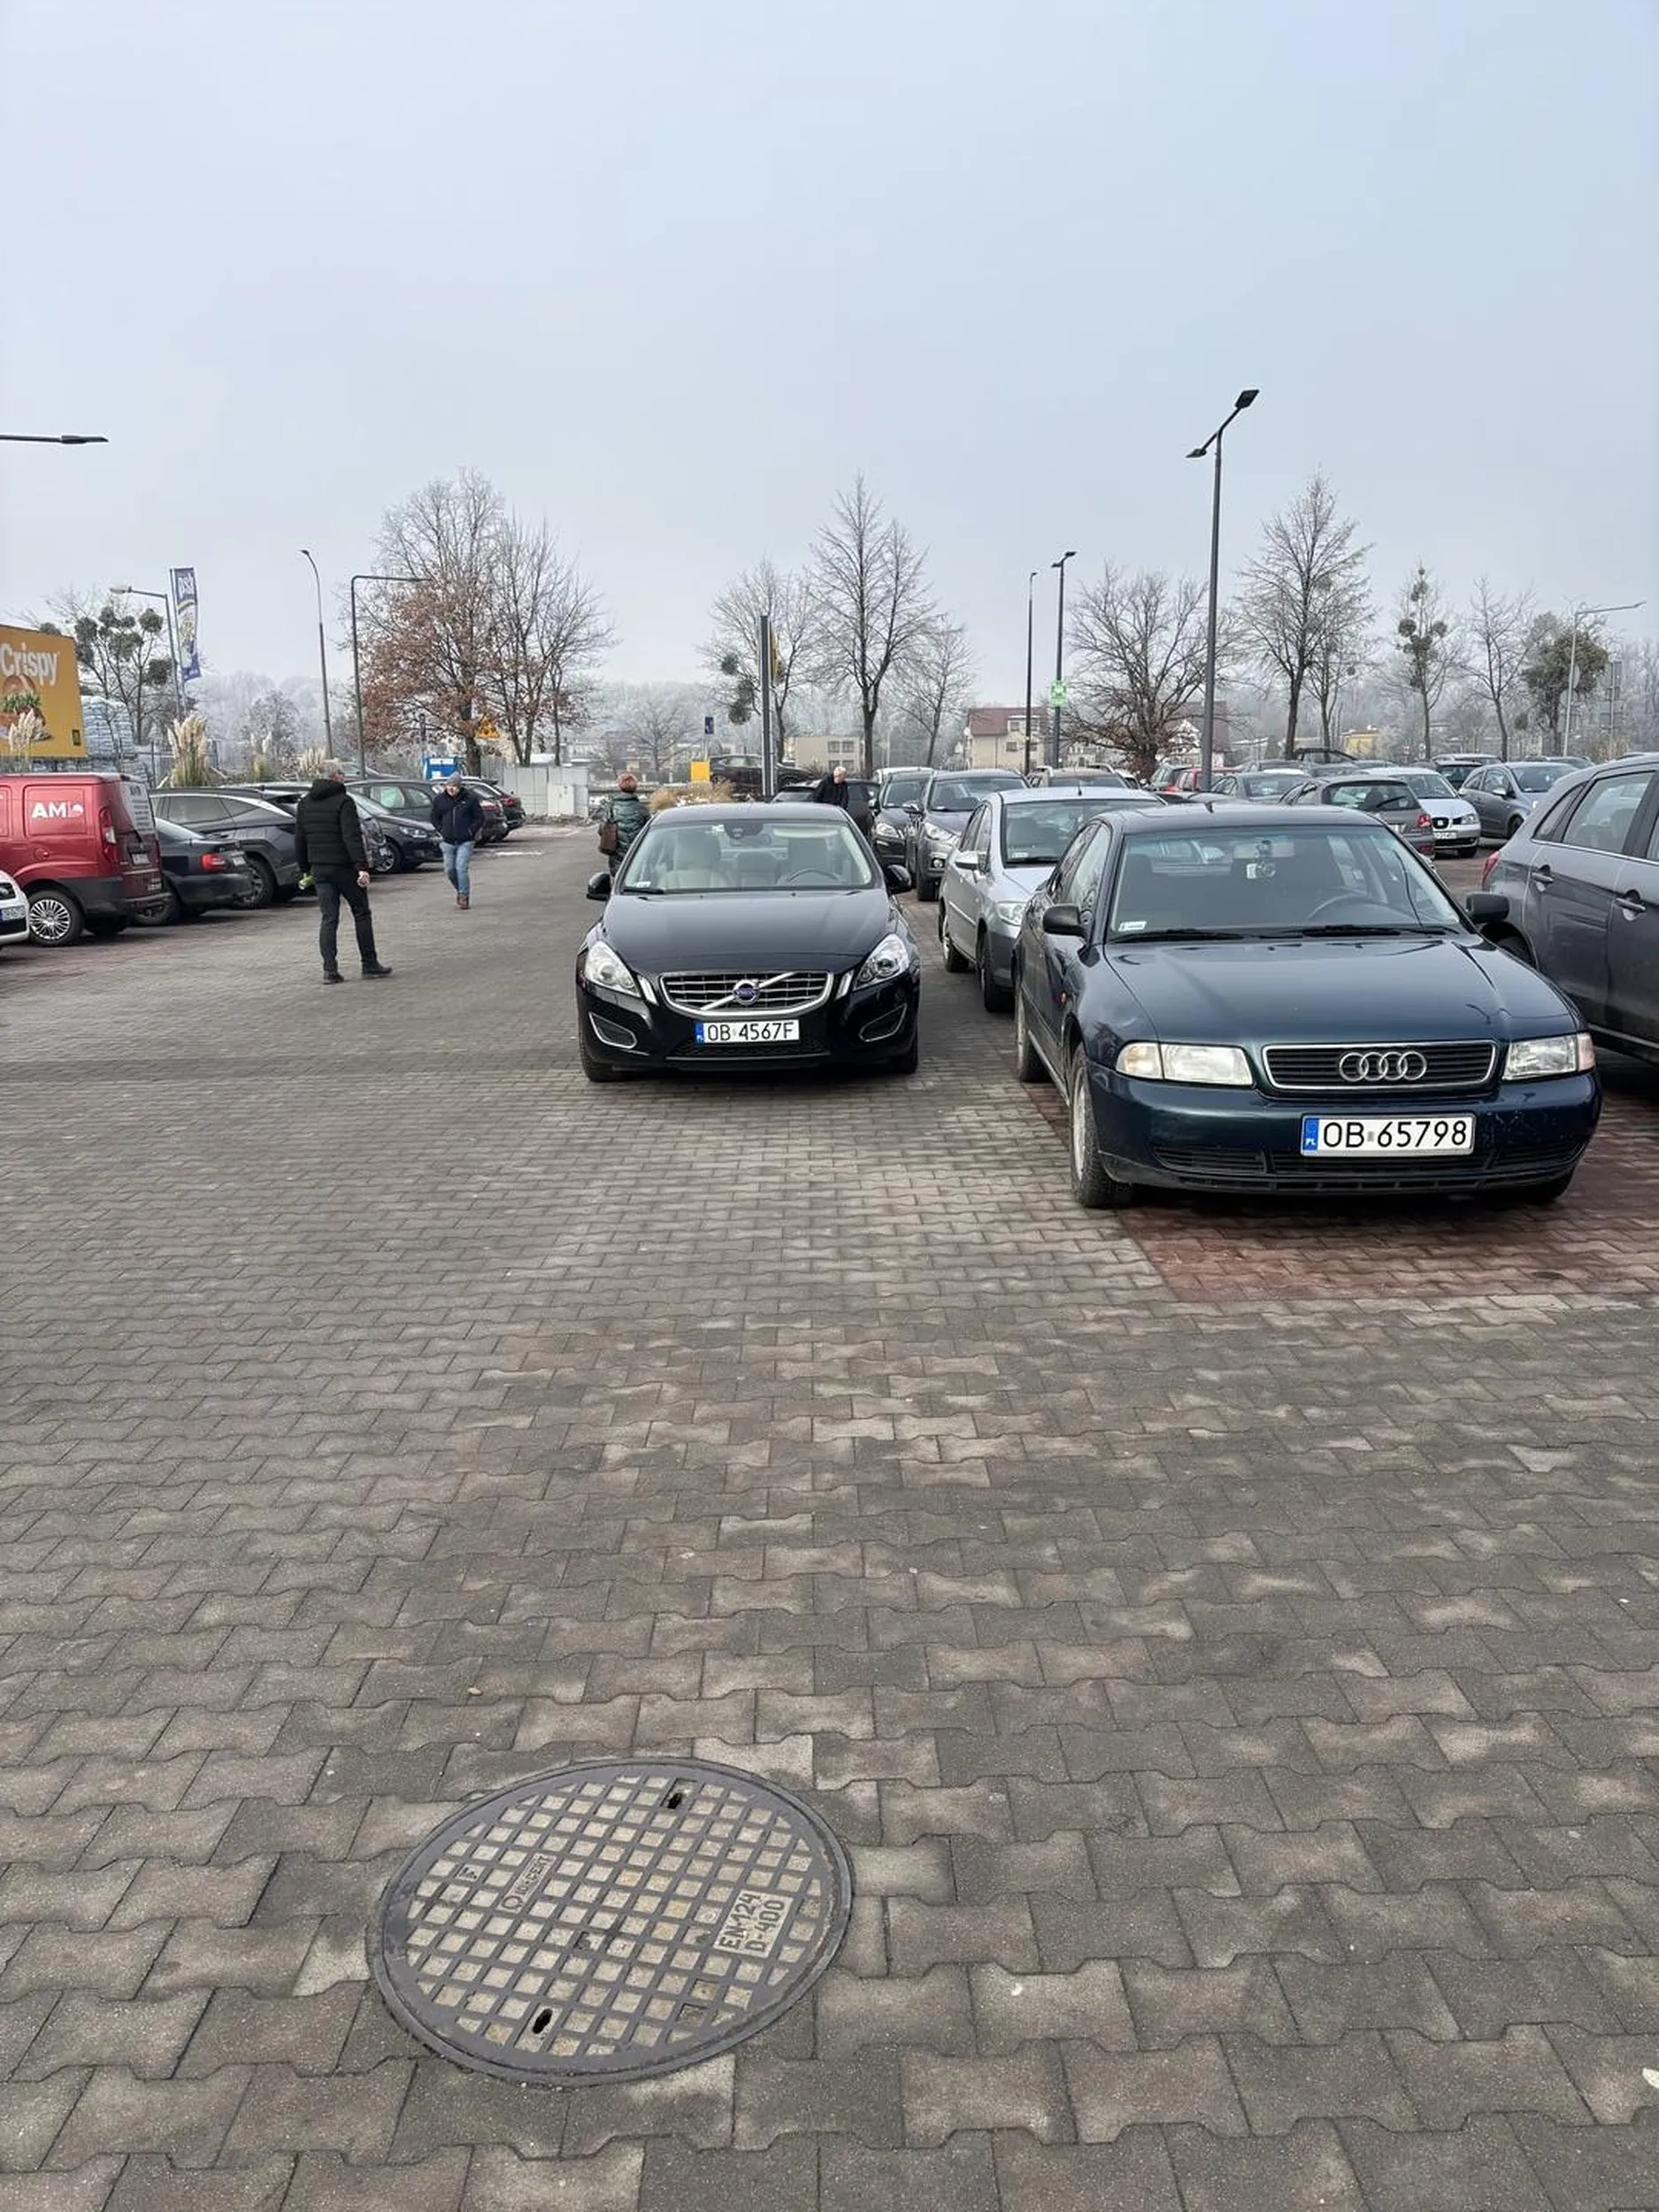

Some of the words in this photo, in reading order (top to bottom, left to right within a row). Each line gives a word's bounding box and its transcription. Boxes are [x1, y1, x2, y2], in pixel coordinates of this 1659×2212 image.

[0, 641, 58, 687] Crispy
[708, 1024, 731, 1041] OB
[739, 1021, 794, 1040] 4567F
[1324, 1122, 1364, 1148] OB
[1377, 1120, 1466, 1148] 65798
[745, 1900, 784, 1953] D-400
